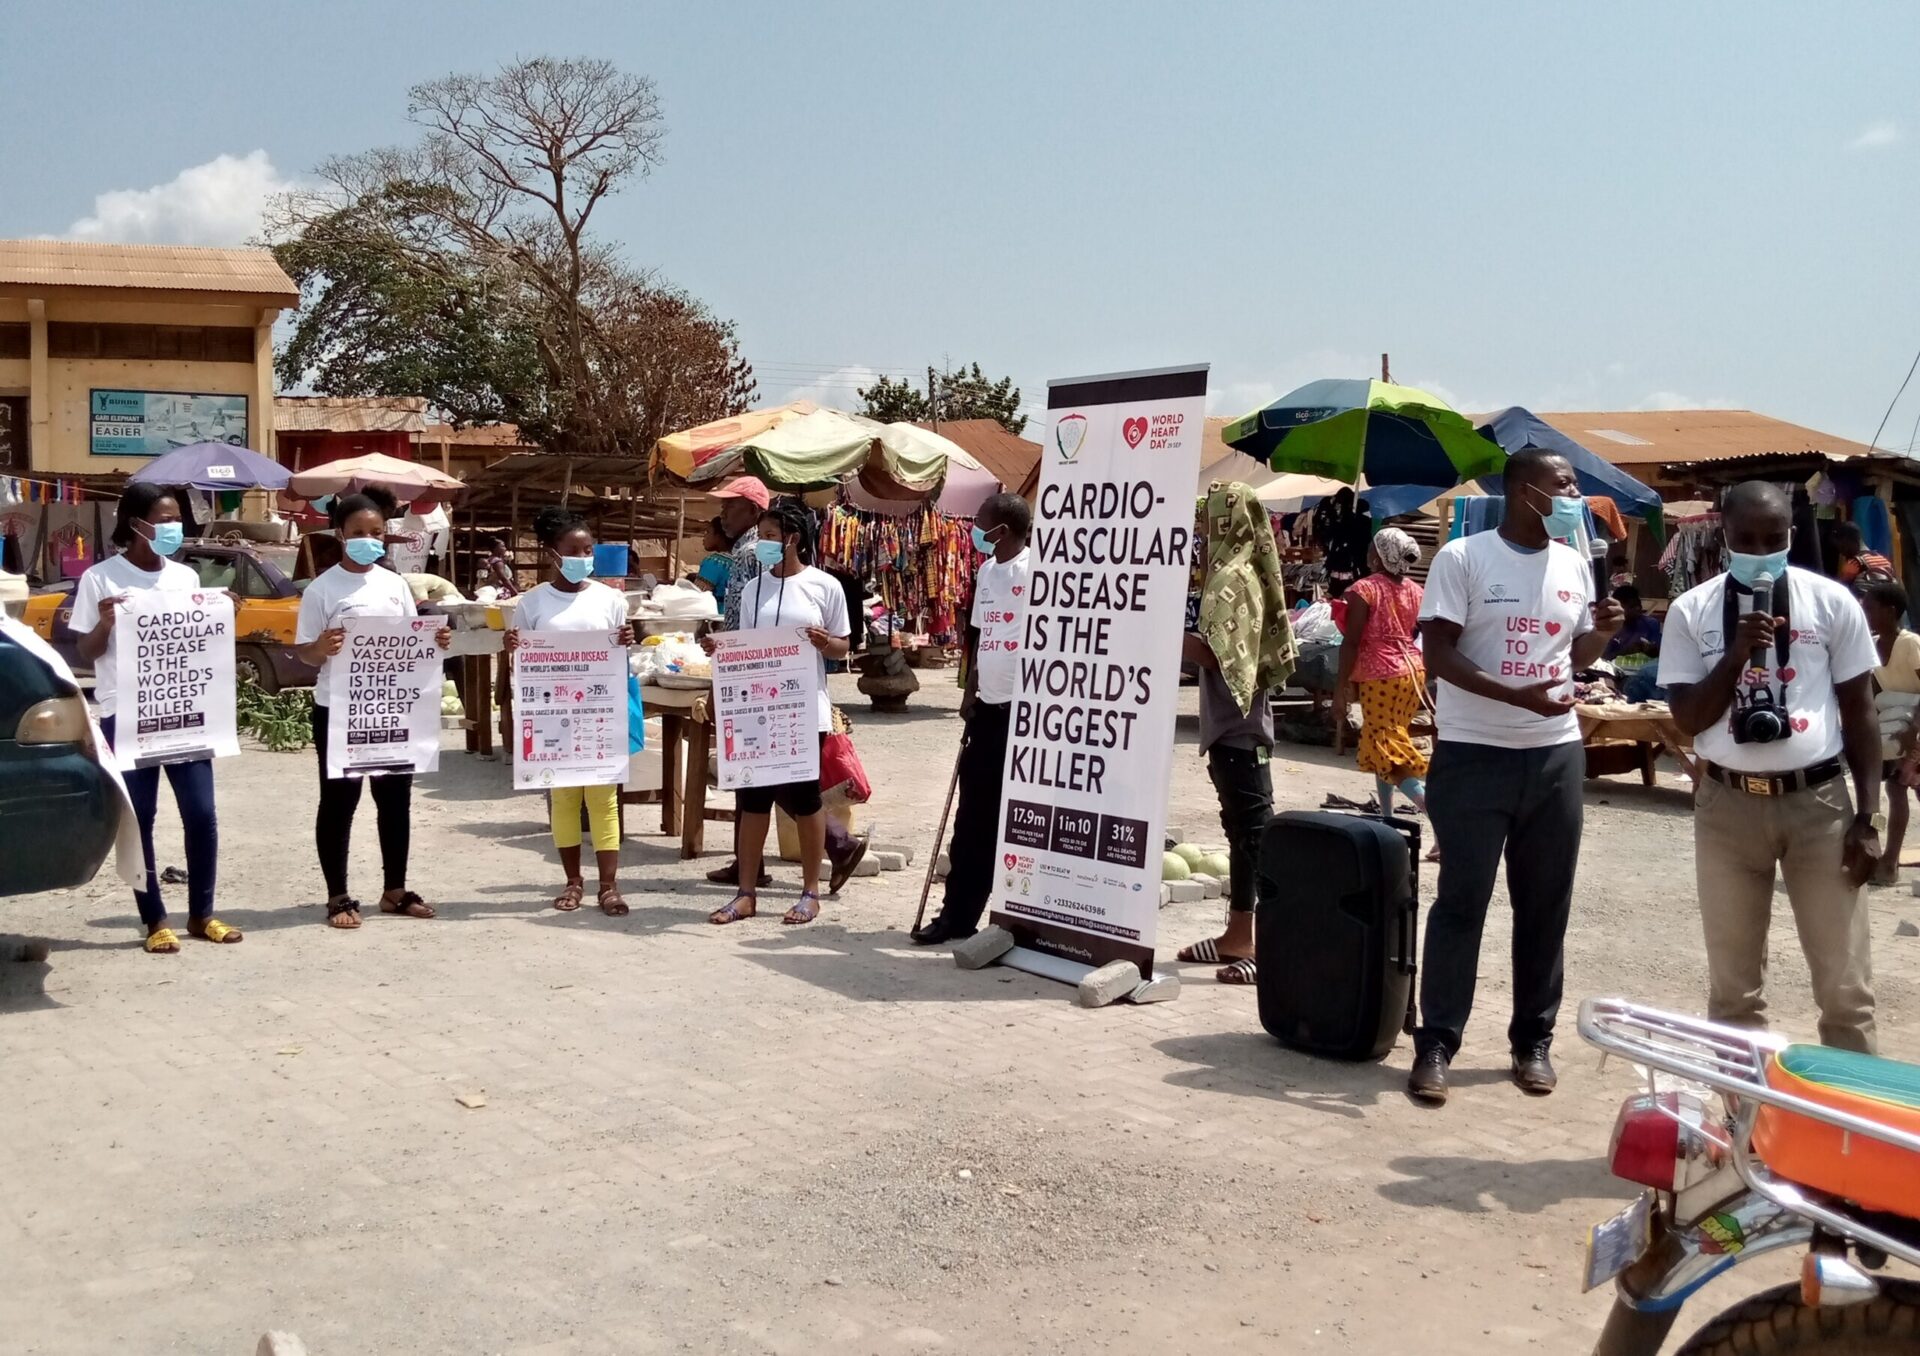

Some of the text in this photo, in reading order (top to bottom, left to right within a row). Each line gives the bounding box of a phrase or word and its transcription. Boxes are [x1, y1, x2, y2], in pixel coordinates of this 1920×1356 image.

[1152, 414, 1184, 424] WORLD
[95, 427, 141, 436] EASIER
[1150, 426, 1180, 438] HEART
[1150, 440, 1167, 450] DAY
[1040, 480, 1165, 520] CARDIO-
[1036, 527, 1188, 566] VASCULAR
[1030, 571, 1149, 611] DISEASE
[138, 610, 210, 628] CARDIO-
[984, 611, 1000, 622] USE
[137, 622, 224, 642] VASCULAR
[1506, 617, 1540, 634] USE
[354, 635, 423, 647] CARDIO-
[1024, 614, 1111, 655] IS THE
[138, 640, 206, 658] DISEASE
[352, 648, 435, 660] VASCULAR
[717, 645, 799, 663] CARDIOVASCULAR DISEASE
[1505, 640, 1528, 655] TO
[138, 656, 188, 673] IS THE
[520, 651, 608, 663] CARDIOVASCULAR DISEASE
[350, 661, 416, 673] DISEASE
[727, 664, 746, 672] WORLD'S
[747, 662, 764, 670] NUMBER
[768, 660, 781, 668] KILLER
[1500, 661, 1545, 678] BEAT
[138, 668, 213, 688] WORLD'S
[350, 674, 397, 687] IS THE
[780, 679, 800, 690] >75%
[1021, 658, 1152, 704] WORLD'S
[138, 683, 207, 703] BIGGEST
[349, 688, 420, 701] WORLD'S
[522, 686, 535, 697] 17.8
[555, 686, 568, 696] 31%
[587, 685, 608, 695] >75%
[721, 686, 733, 697] 17.8
[751, 684, 763, 694] 31%
[138, 700, 193, 718] KILLER
[349, 702, 413, 716] BIGGEST
[348, 716, 400, 730] KILLER
[1015, 701, 1137, 750] BIGGEST
[1010, 745, 1105, 794] KILLER
[1013, 807, 1045, 827] 17.9m
[1059, 815, 1091, 834] 1 in 10
[1112, 824, 1135, 843] 31%
[1054, 898, 1106, 916] +233262463986
